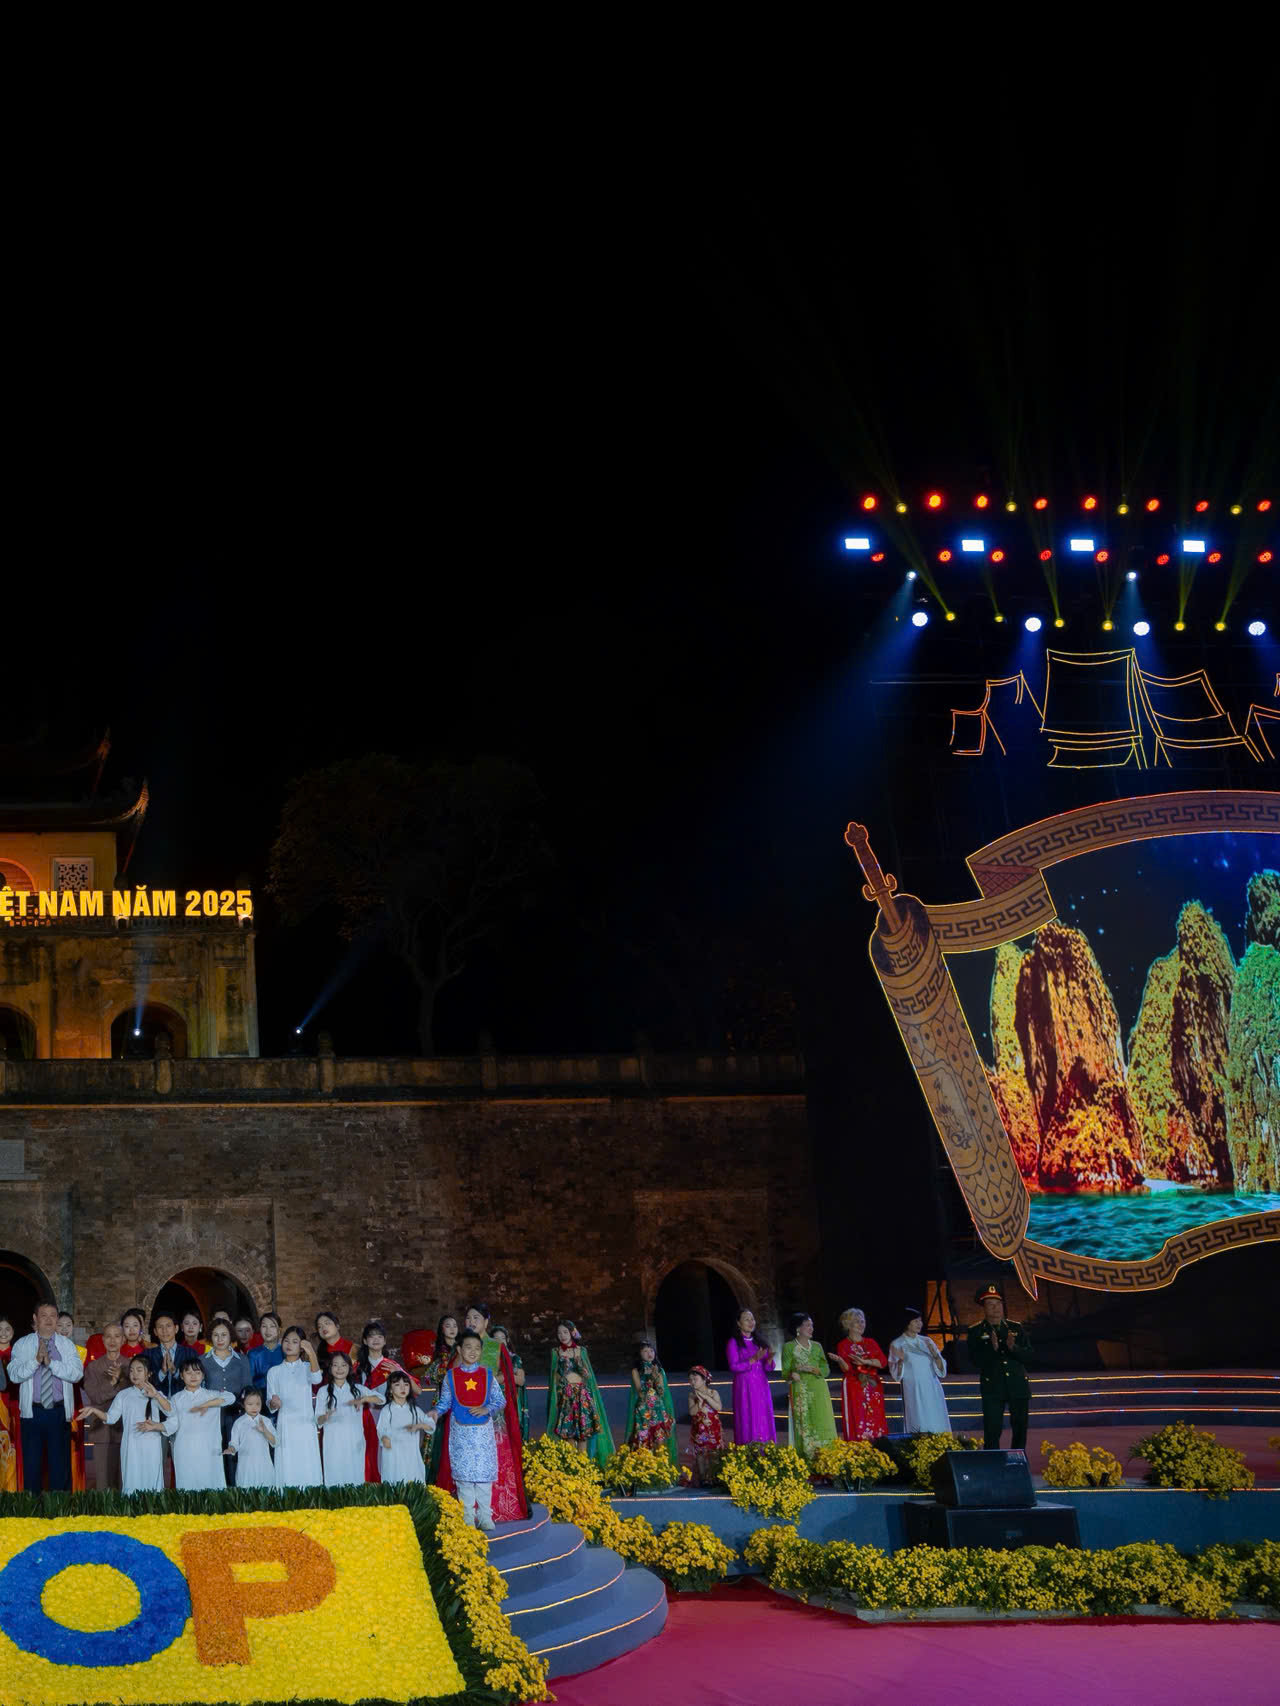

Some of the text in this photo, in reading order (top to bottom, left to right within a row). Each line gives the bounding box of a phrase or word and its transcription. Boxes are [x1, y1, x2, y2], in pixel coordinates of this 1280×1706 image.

[39, 890, 104, 916] NAM
[112, 884, 176, 916] NĂM
[185, 890, 252, 916] 2025
